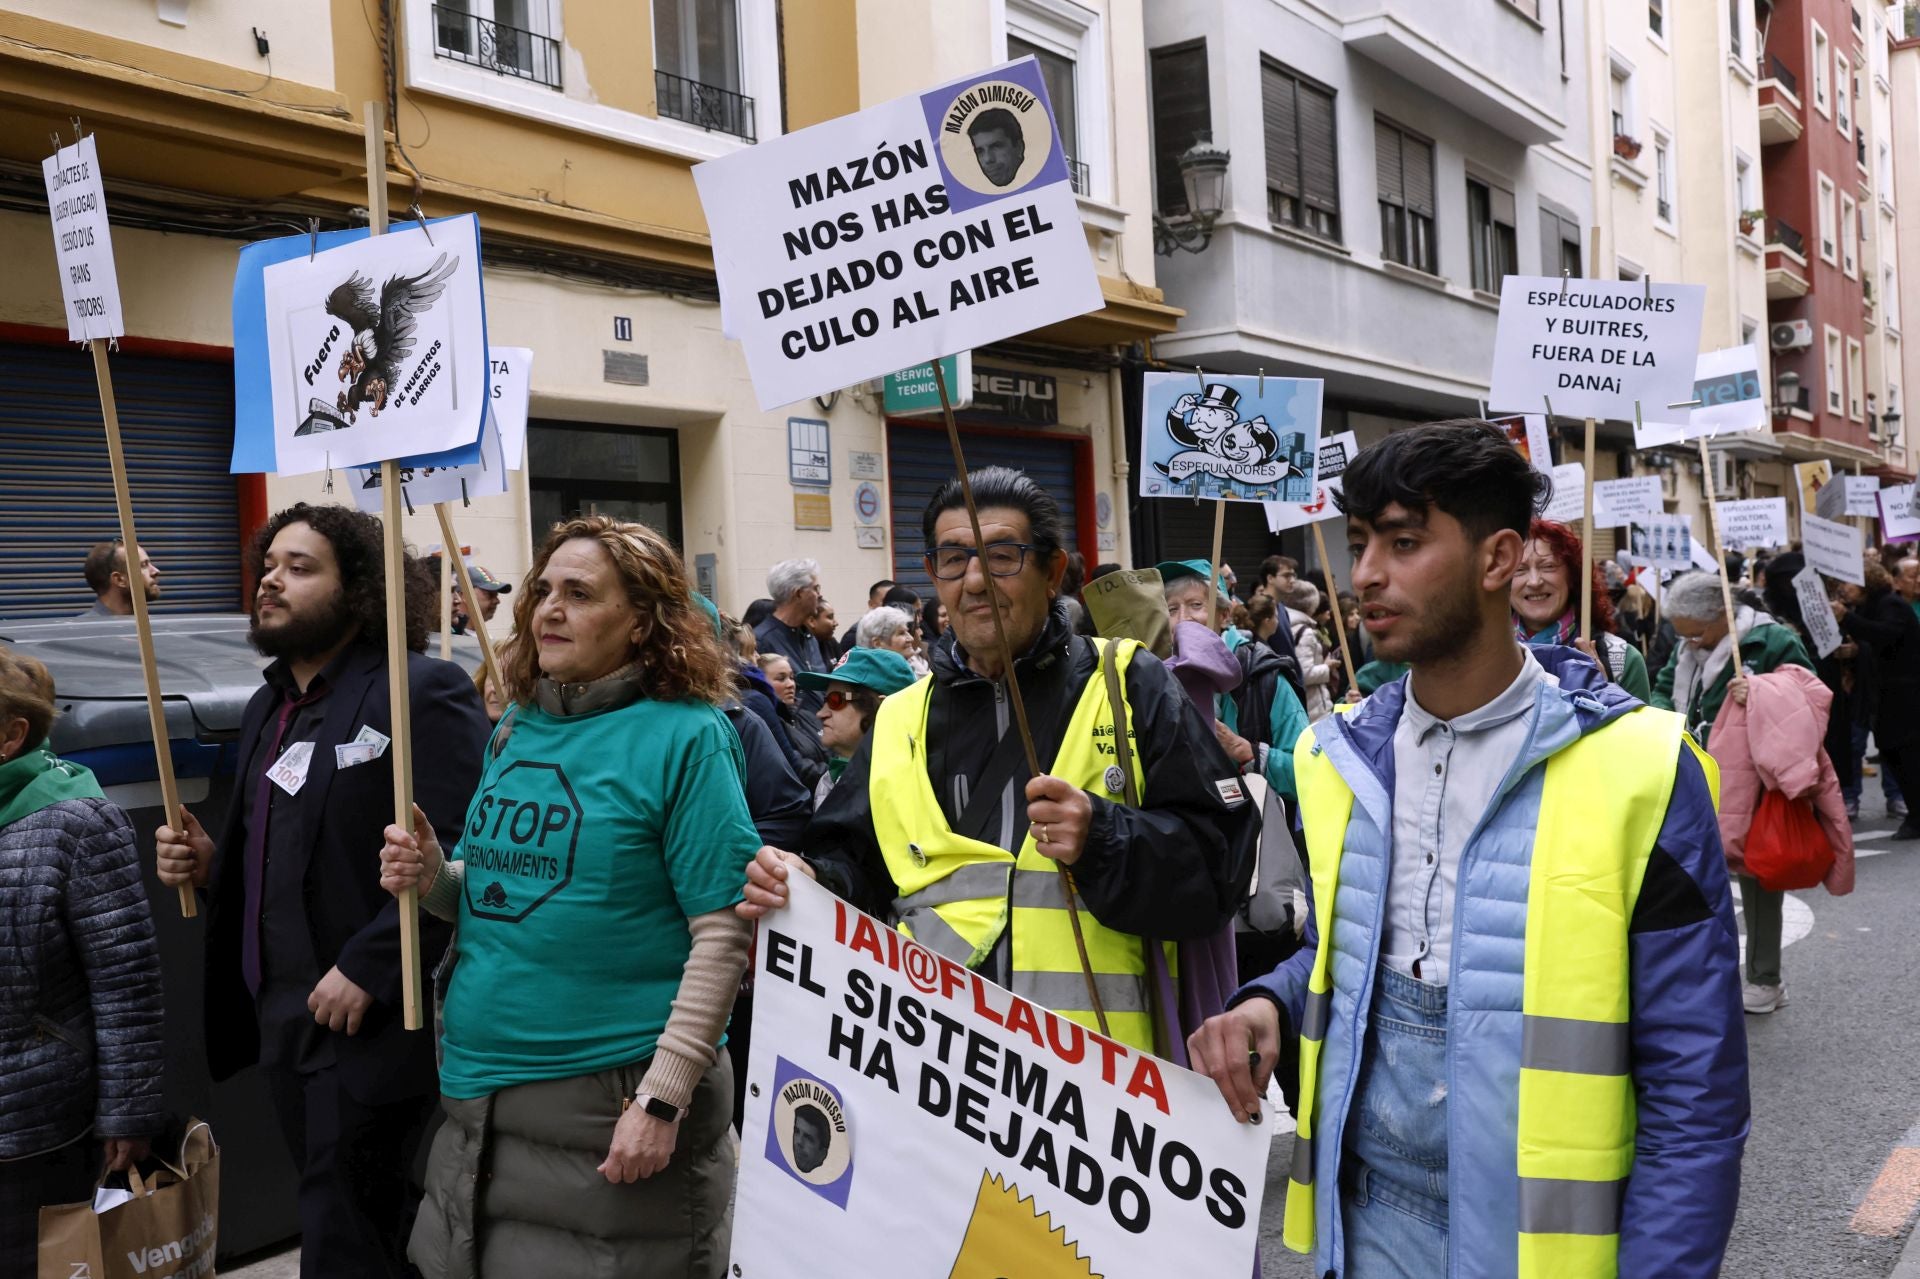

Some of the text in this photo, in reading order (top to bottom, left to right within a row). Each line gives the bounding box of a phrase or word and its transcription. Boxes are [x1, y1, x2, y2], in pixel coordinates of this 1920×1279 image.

[945, 85, 1037, 134] MAZÓN DIMISSIÓ
[788, 138, 928, 209] MAZÓN
[783, 184, 950, 261] NOS HAS
[757, 204, 1053, 319] DEJADO CON EL
[781, 256, 1040, 360] CULO AL AIRE
[1527, 291, 1675, 313] ESPECULADORES
[1546, 318, 1650, 341] Y BUITRES,
[303, 324, 341, 386] Fuera
[394, 339, 442, 409] DE NUESTROS
[895, 365, 945, 382] SERVICO
[1532, 344, 1656, 367] FUERA DE LA
[410, 362, 442, 406] BARRIOS
[1172, 460, 1276, 477] ESPECULADORES
[1318, 454, 1345, 468] CTADOS
[1319, 446, 1343, 459] ORMA
[275, 765, 301, 787] 100
[471, 795, 570, 848] STOP
[467, 844, 558, 881] DESNONAMENTS
[766, 929, 1247, 1230] EL SISTEMA NOS
[828, 1014, 1151, 1234] HA DEJADO
